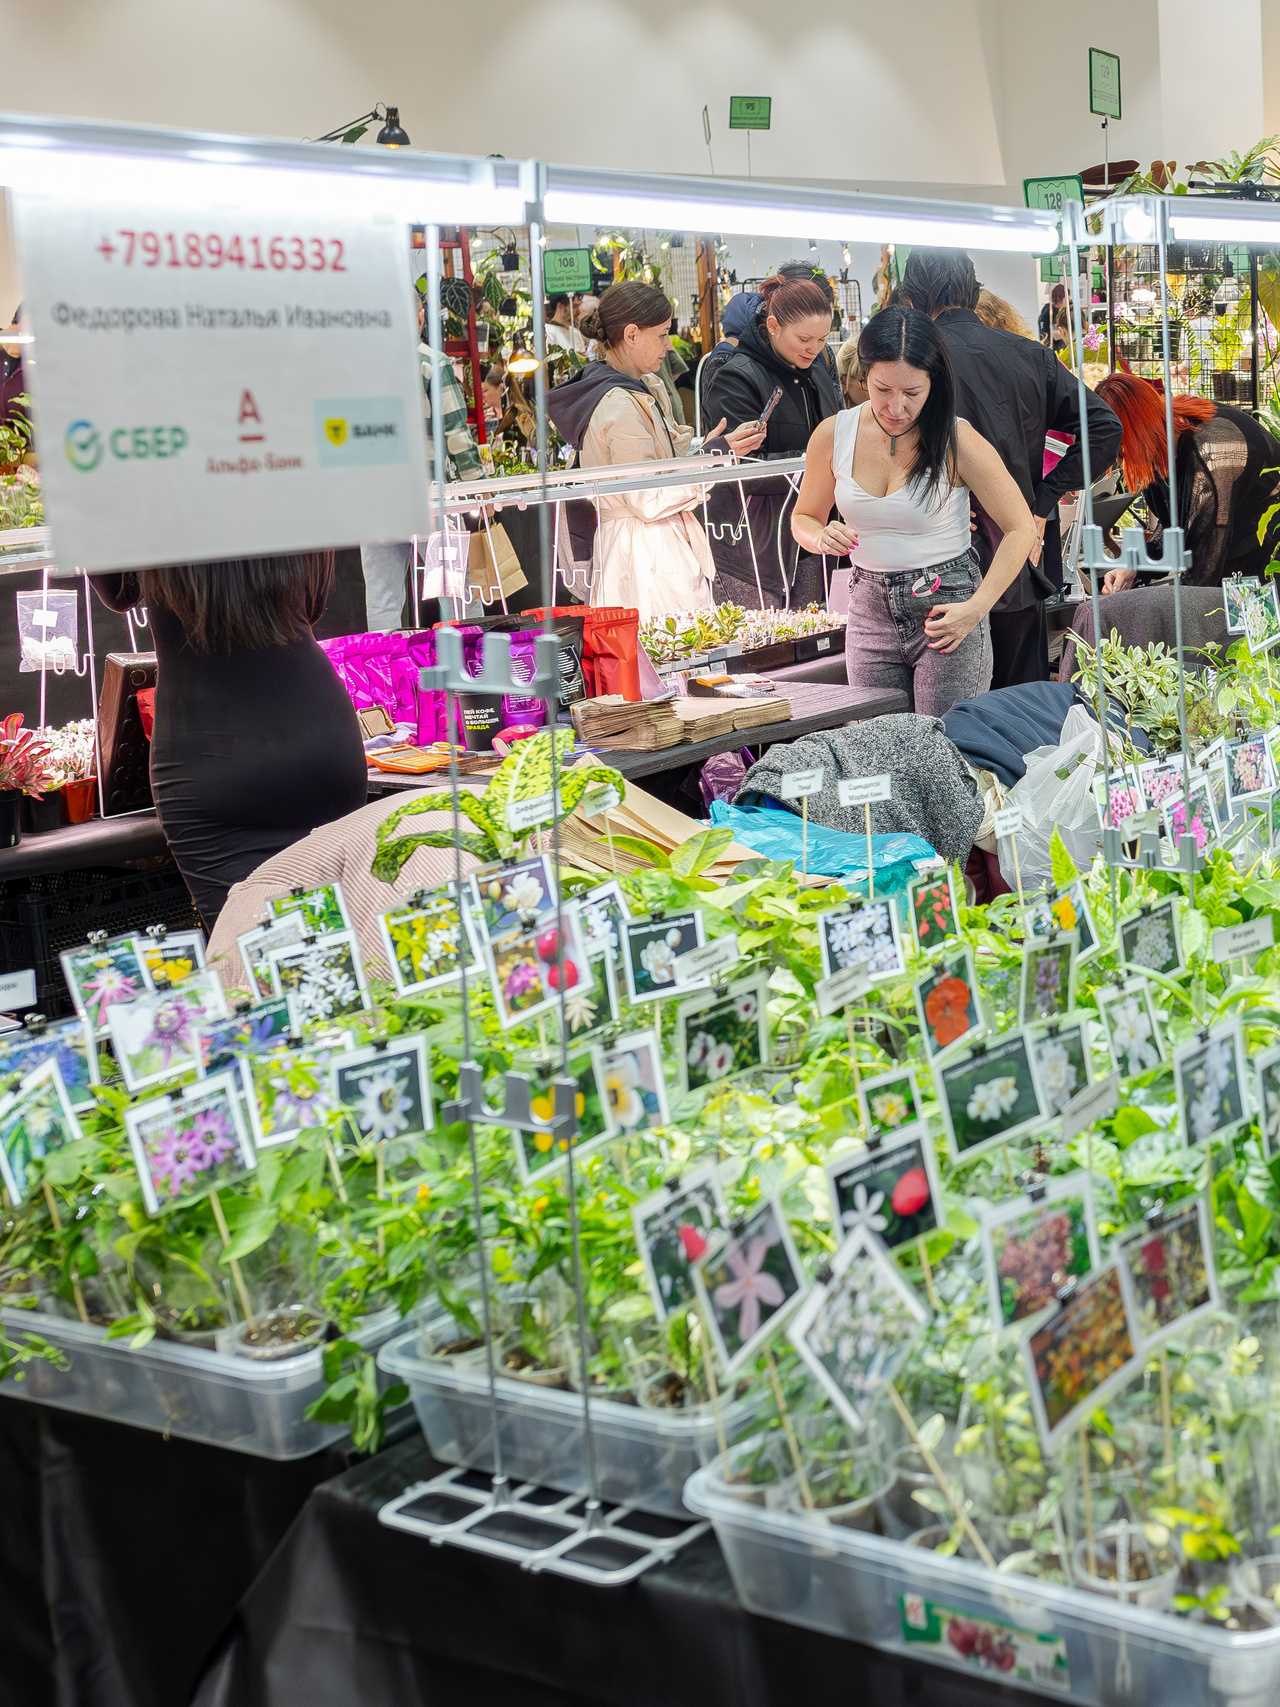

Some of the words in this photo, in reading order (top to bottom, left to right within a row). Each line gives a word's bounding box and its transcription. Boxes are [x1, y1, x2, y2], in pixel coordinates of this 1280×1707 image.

[1043, 191, 1063, 210] 128
[96, 230, 348, 272] +79189416332
[558, 257, 575, 268] 108
[51, 301, 181, 334] Федорова
[184, 302, 282, 331] Наталья
[286, 303, 394, 330] Ивановна
[109, 425, 189, 461] СБЕР
[352, 422, 397, 438] БАНК
